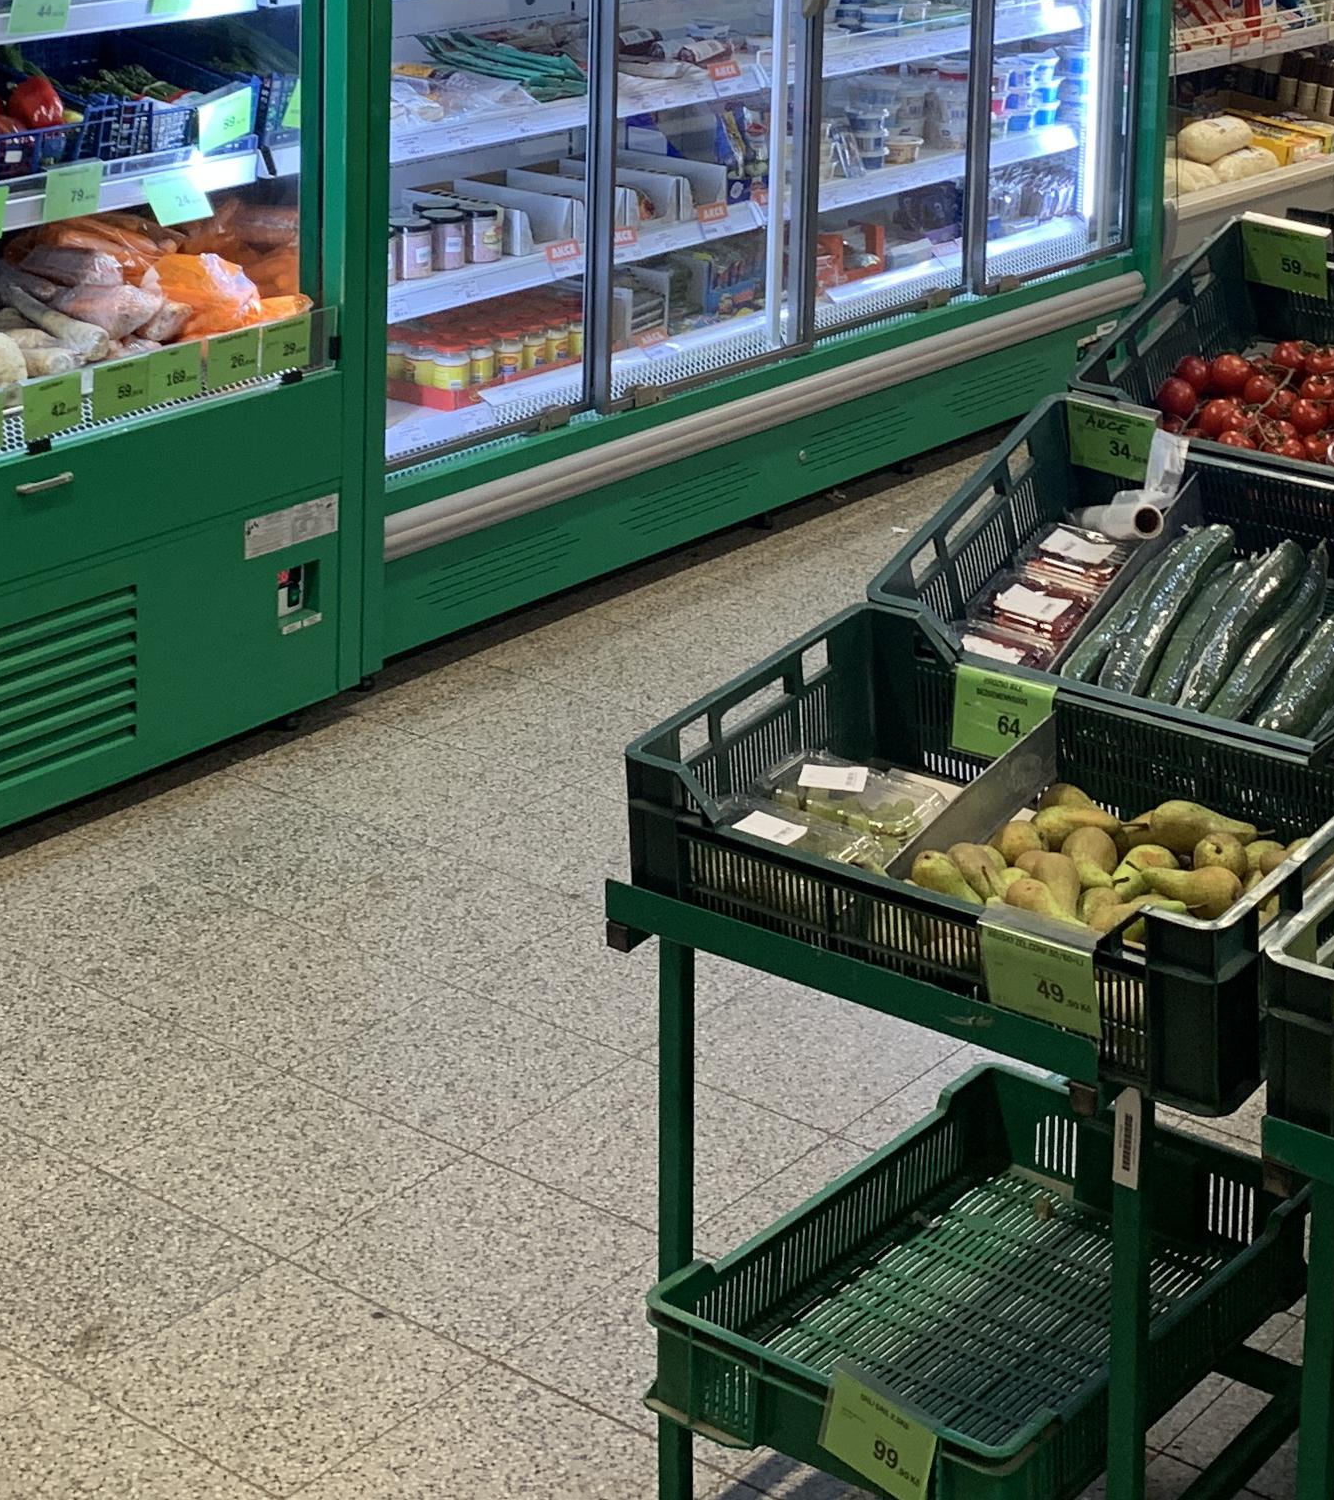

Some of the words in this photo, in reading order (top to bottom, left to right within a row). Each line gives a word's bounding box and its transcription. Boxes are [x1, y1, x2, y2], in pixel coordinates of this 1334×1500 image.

[1280, 257, 1302, 276] 59
[51, 402, 66, 417] 42
[1084, 413, 1132, 436] AKCE
[1109, 440, 1131, 460] 34
[997, 715, 1021, 738] 64
[1036, 979, 1065, 1004] 49
